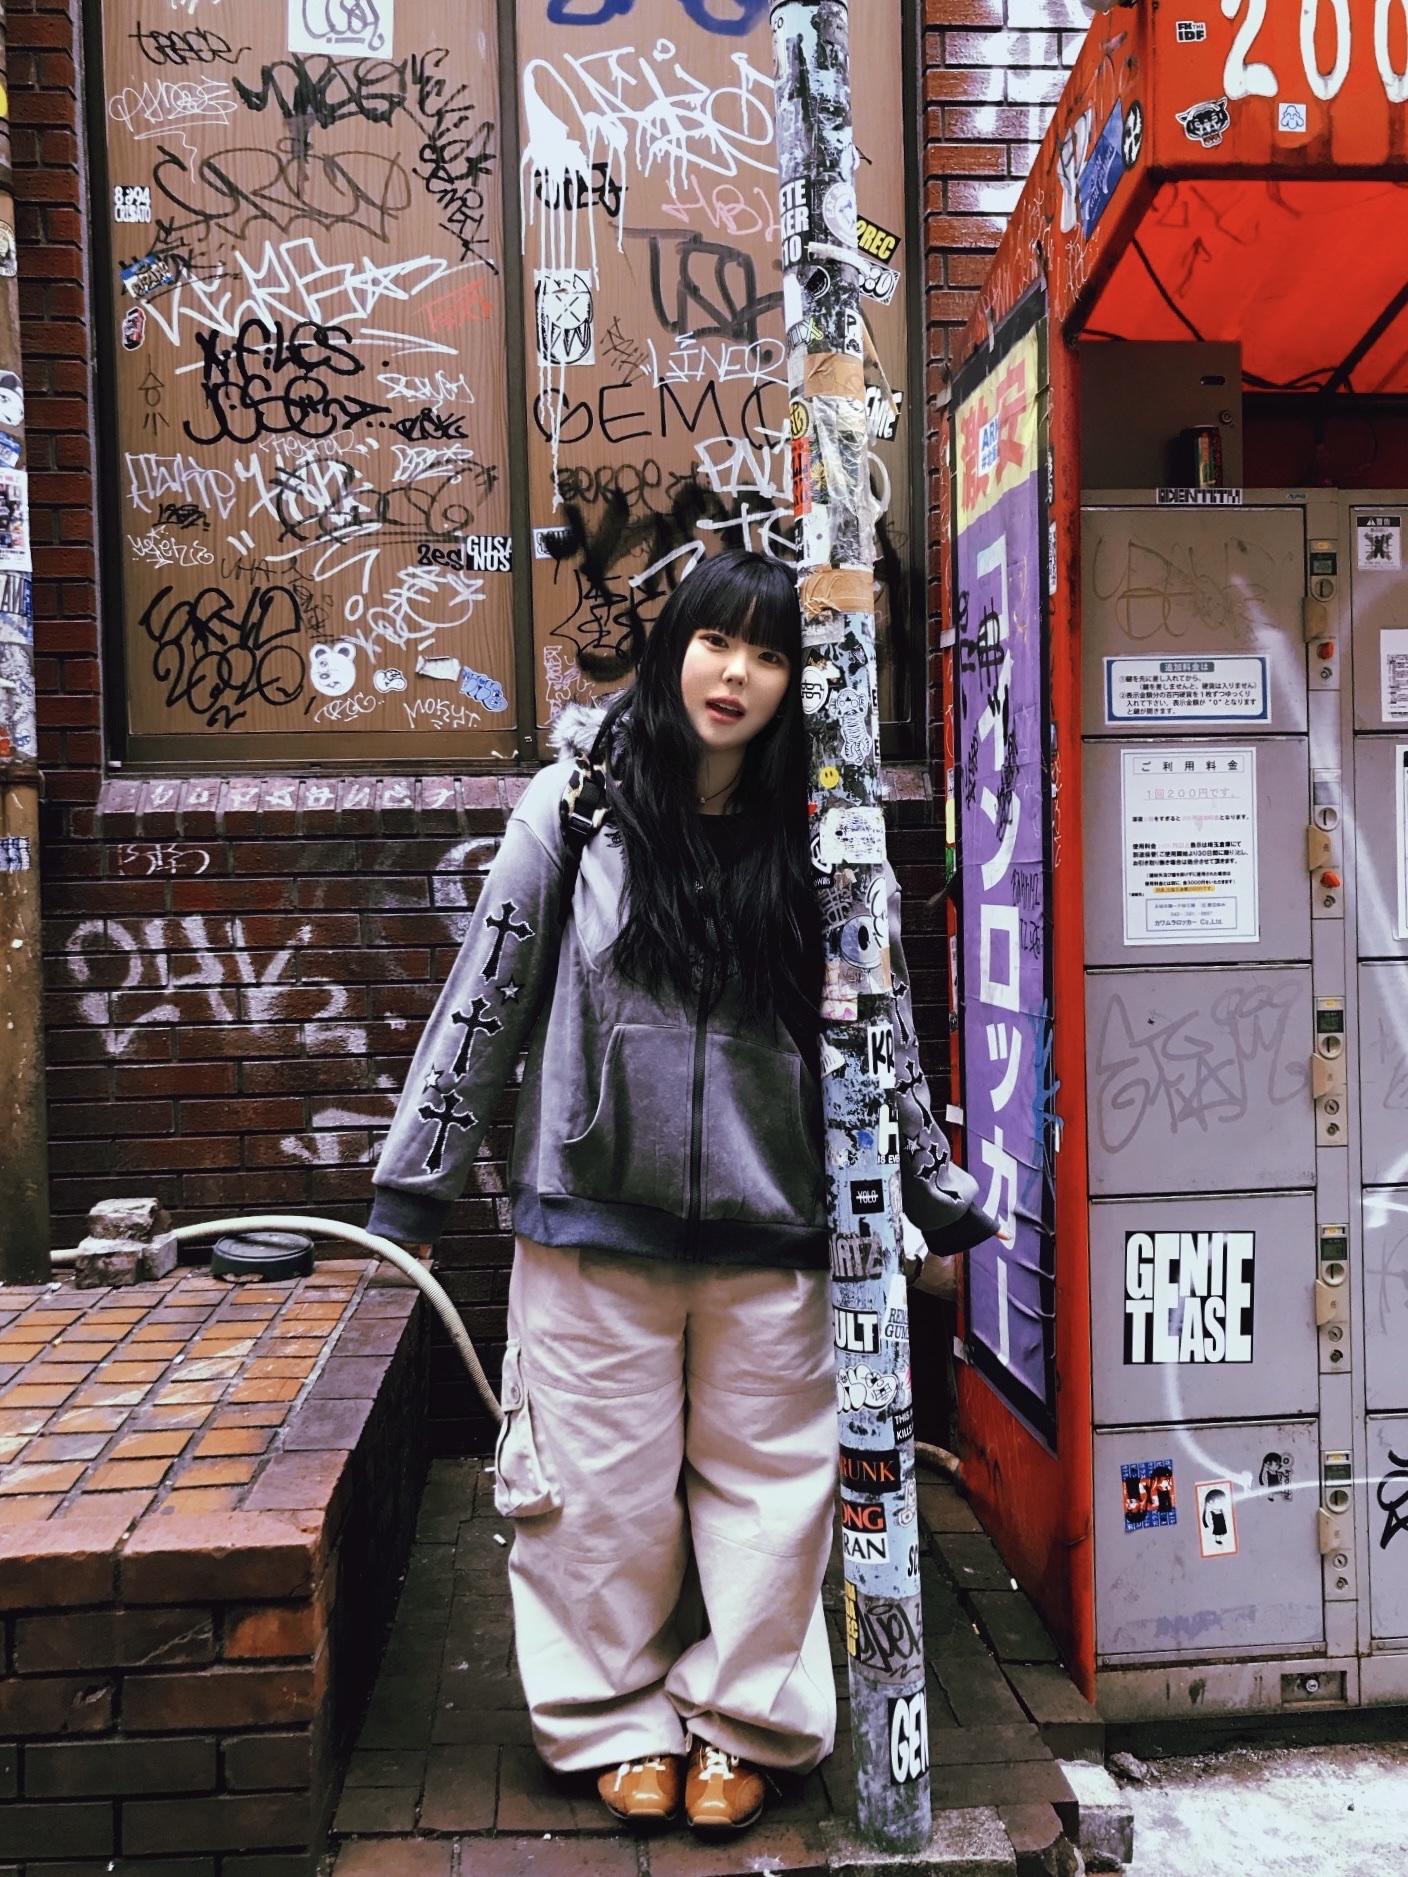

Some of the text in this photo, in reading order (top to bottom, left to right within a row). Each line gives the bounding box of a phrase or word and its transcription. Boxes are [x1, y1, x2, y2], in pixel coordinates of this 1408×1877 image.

[1178, 30, 1204, 41] IDF
[1164, 662, 1209, 672] 追加料金は
[1142, 759, 1238, 772] ご利用料金
[1126, 1232, 1254, 1300] GENIE
[1125, 1297, 1252, 1363] TEASE
